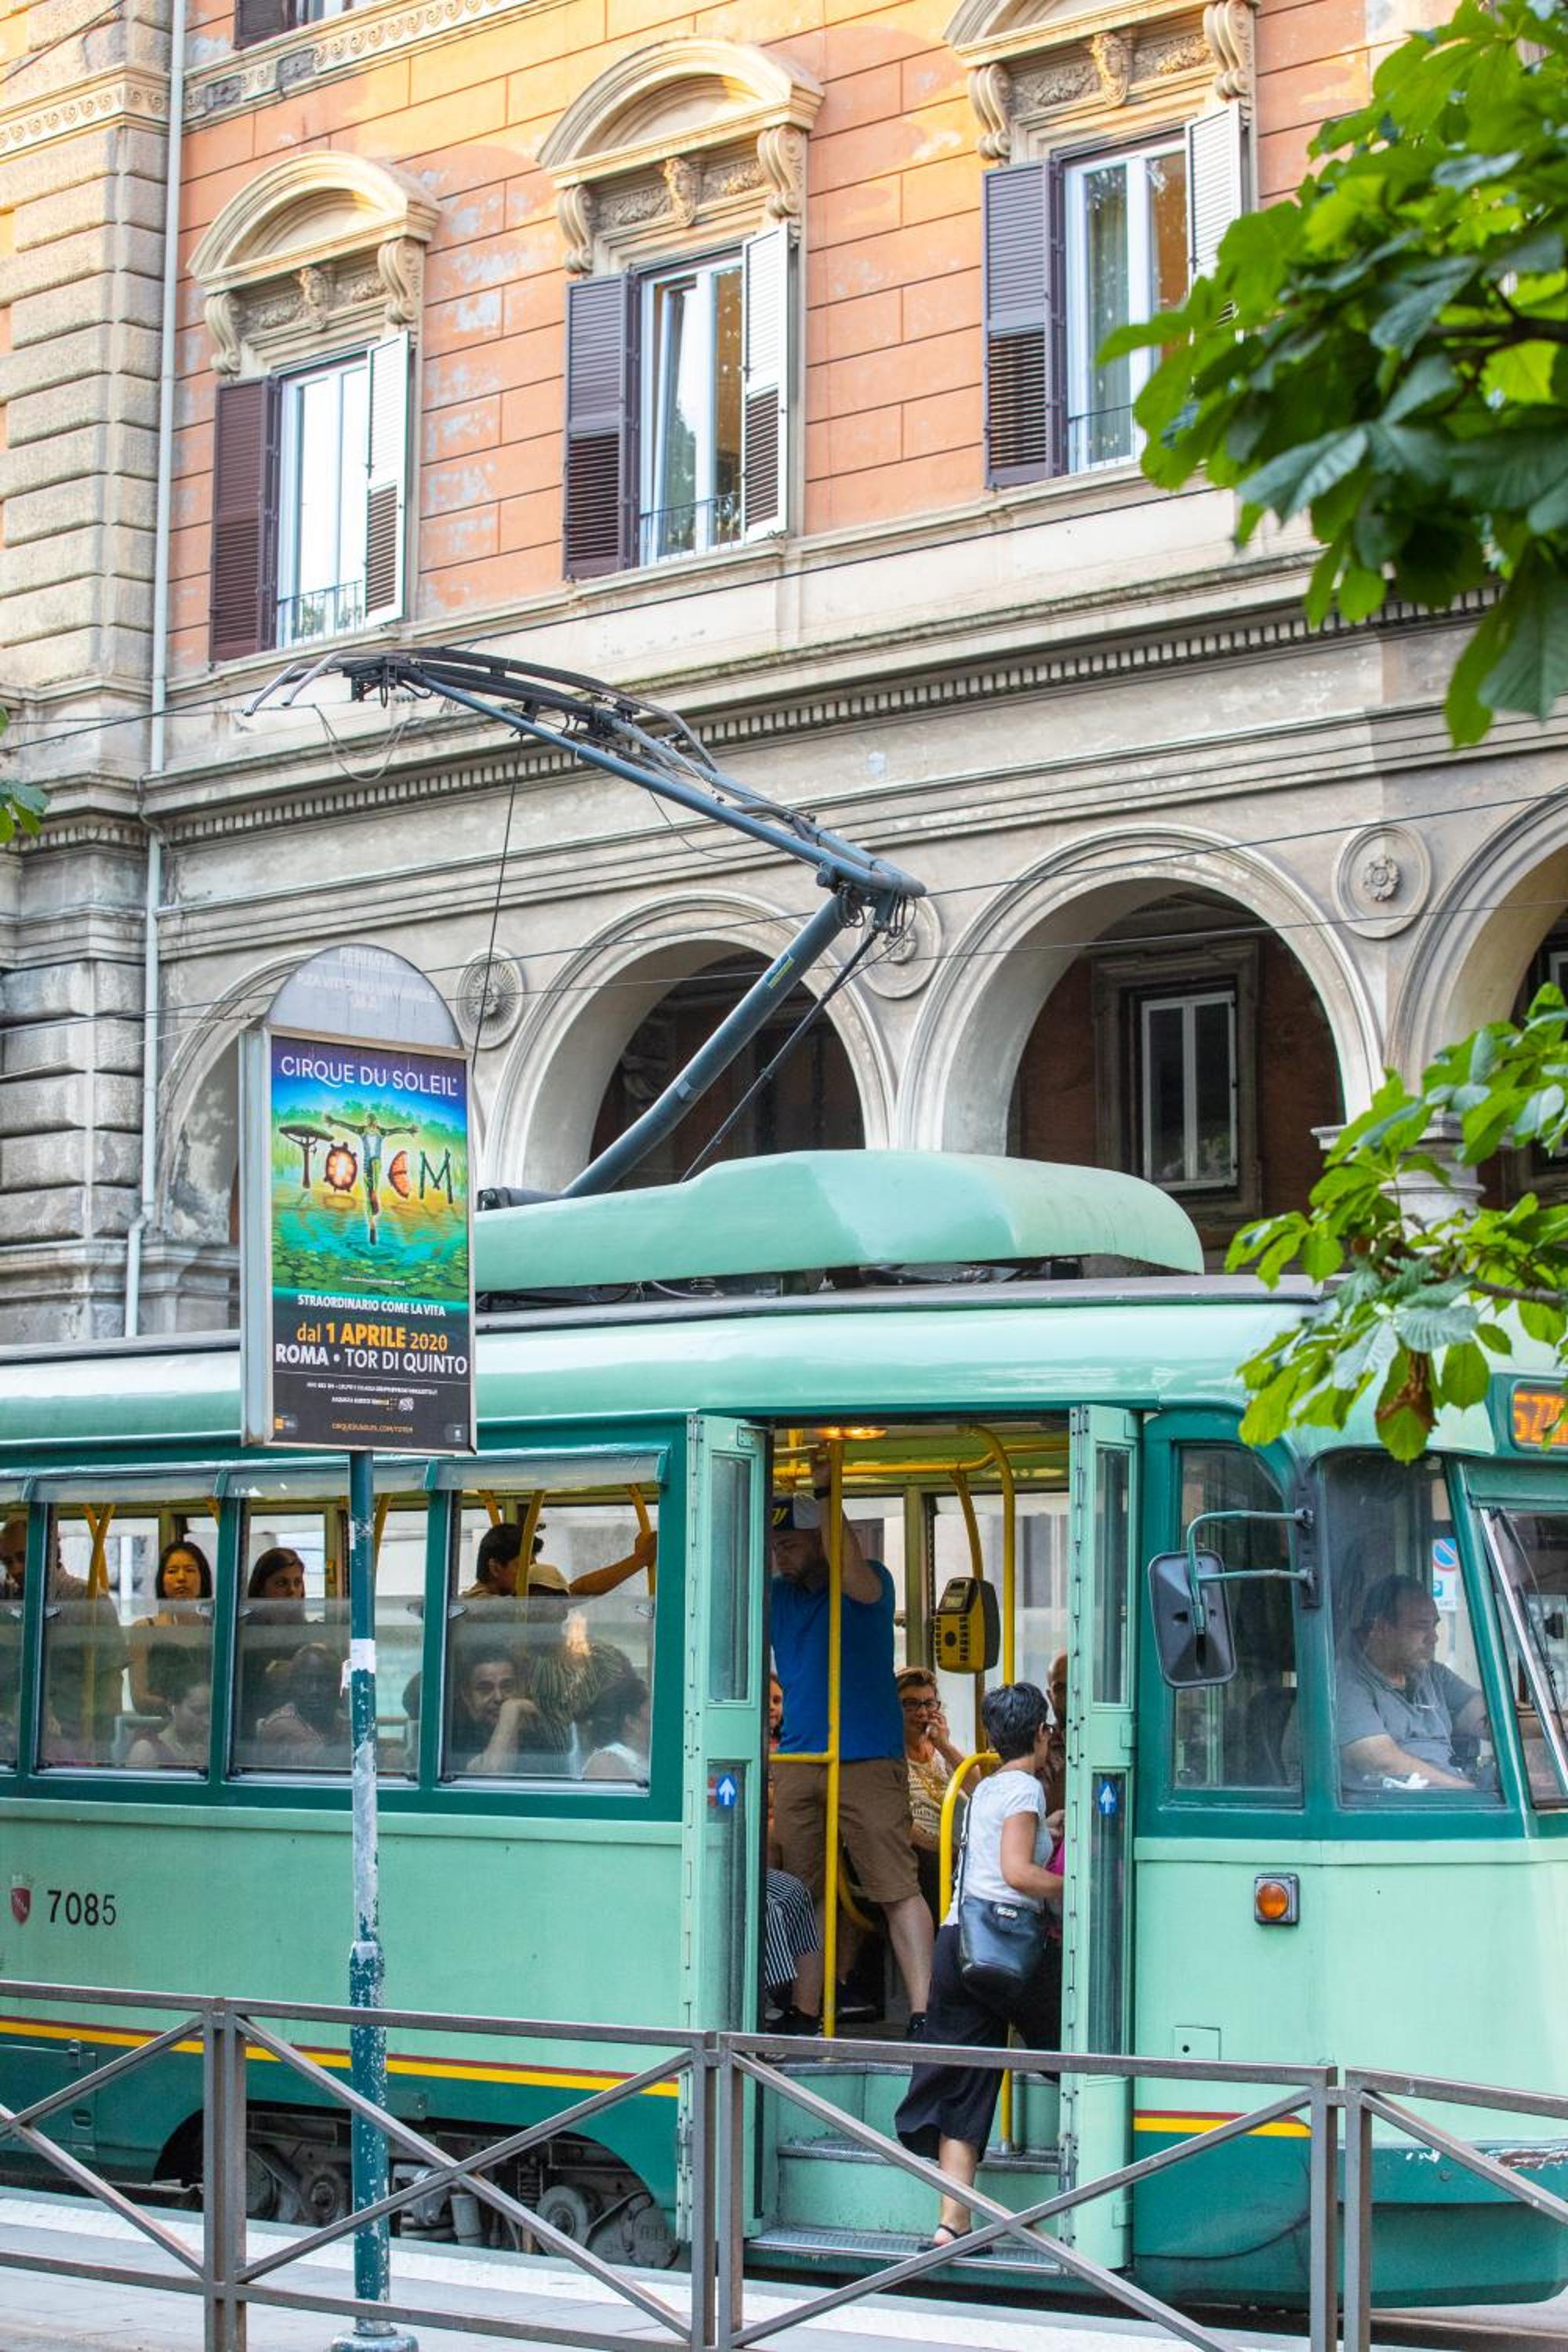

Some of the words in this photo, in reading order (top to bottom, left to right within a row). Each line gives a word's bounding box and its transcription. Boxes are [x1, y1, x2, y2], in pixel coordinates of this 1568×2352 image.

[281, 1056, 355, 1088] CIRQUE
[360, 1065, 387, 1087] DU
[392, 1070, 458, 1096] SOLEIL
[297, 1294, 378, 1312] STRAORDINARIO
[381, 1301, 409, 1314] COME
[410, 1304, 423, 1315] LA
[423, 1305, 446, 1317] VITA
[296, 1322, 321, 1343] dal
[325, 1322, 336, 1344] 1
[339, 1323, 406, 1348] APRILE
[409, 1332, 448, 1352] 2020
[274, 1343, 329, 1367] ROMA
[344, 1348, 378, 1370] TOR
[382, 1352, 399, 1370] DI
[403, 1352, 468, 1374] QUINTO
[46, 1889, 117, 1926] 7085
